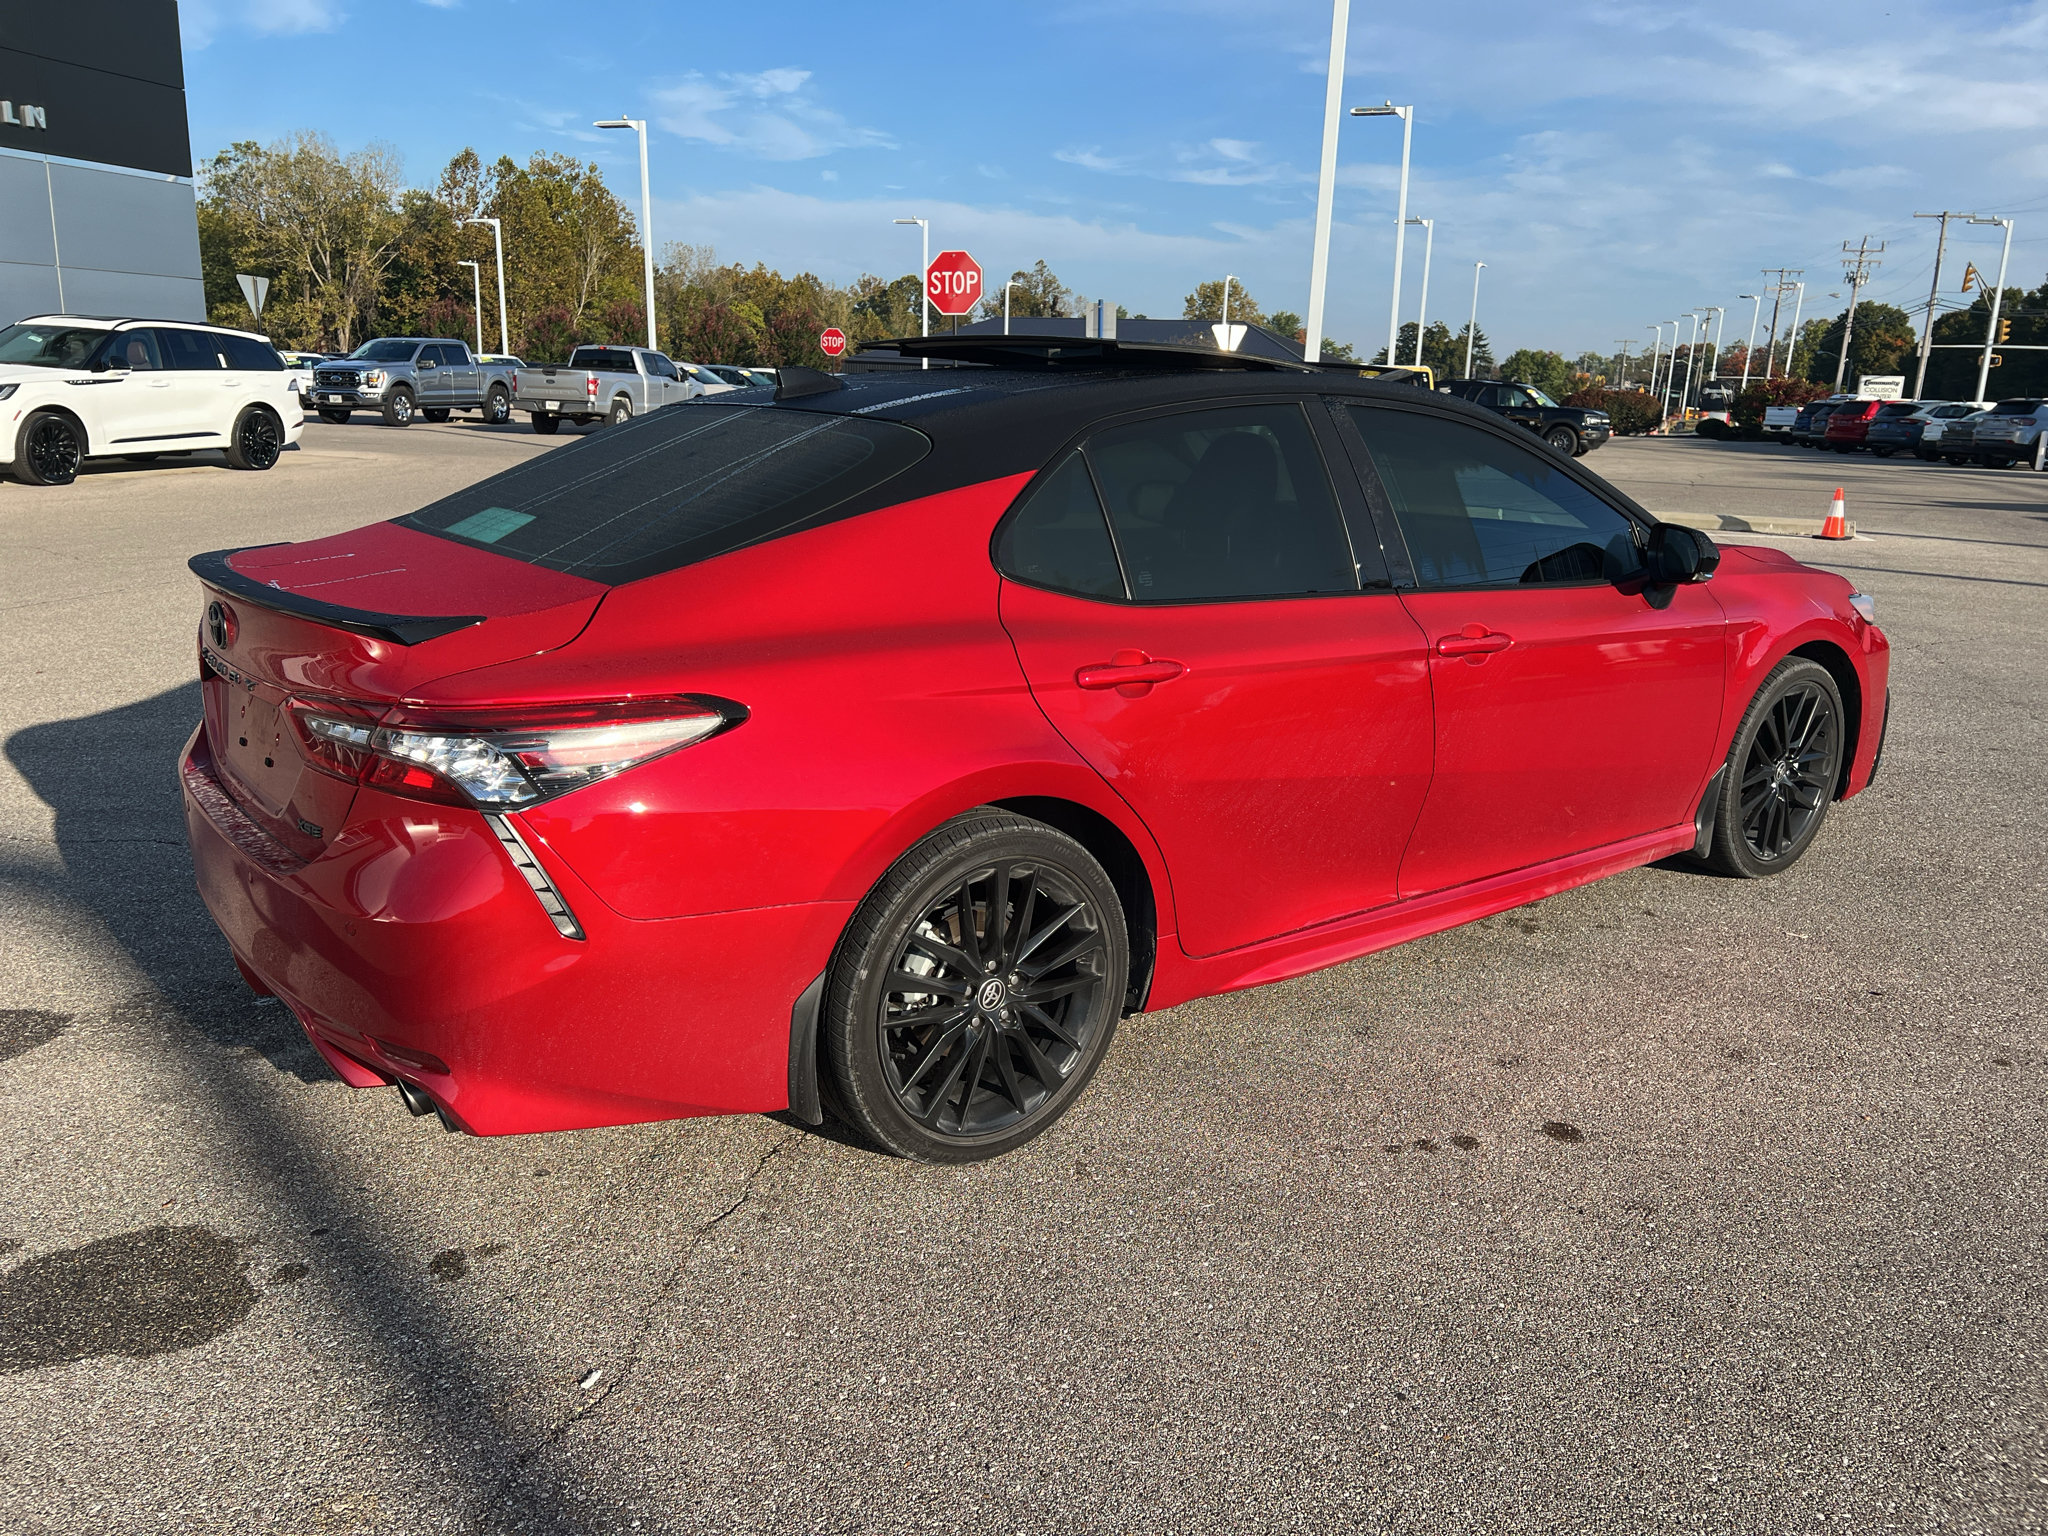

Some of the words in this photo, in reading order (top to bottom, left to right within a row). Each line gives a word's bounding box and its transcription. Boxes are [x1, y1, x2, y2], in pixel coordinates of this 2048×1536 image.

[930, 271, 978, 294] STOP
[822, 336, 844, 347] STOP
[297, 818, 323, 838] XSE
